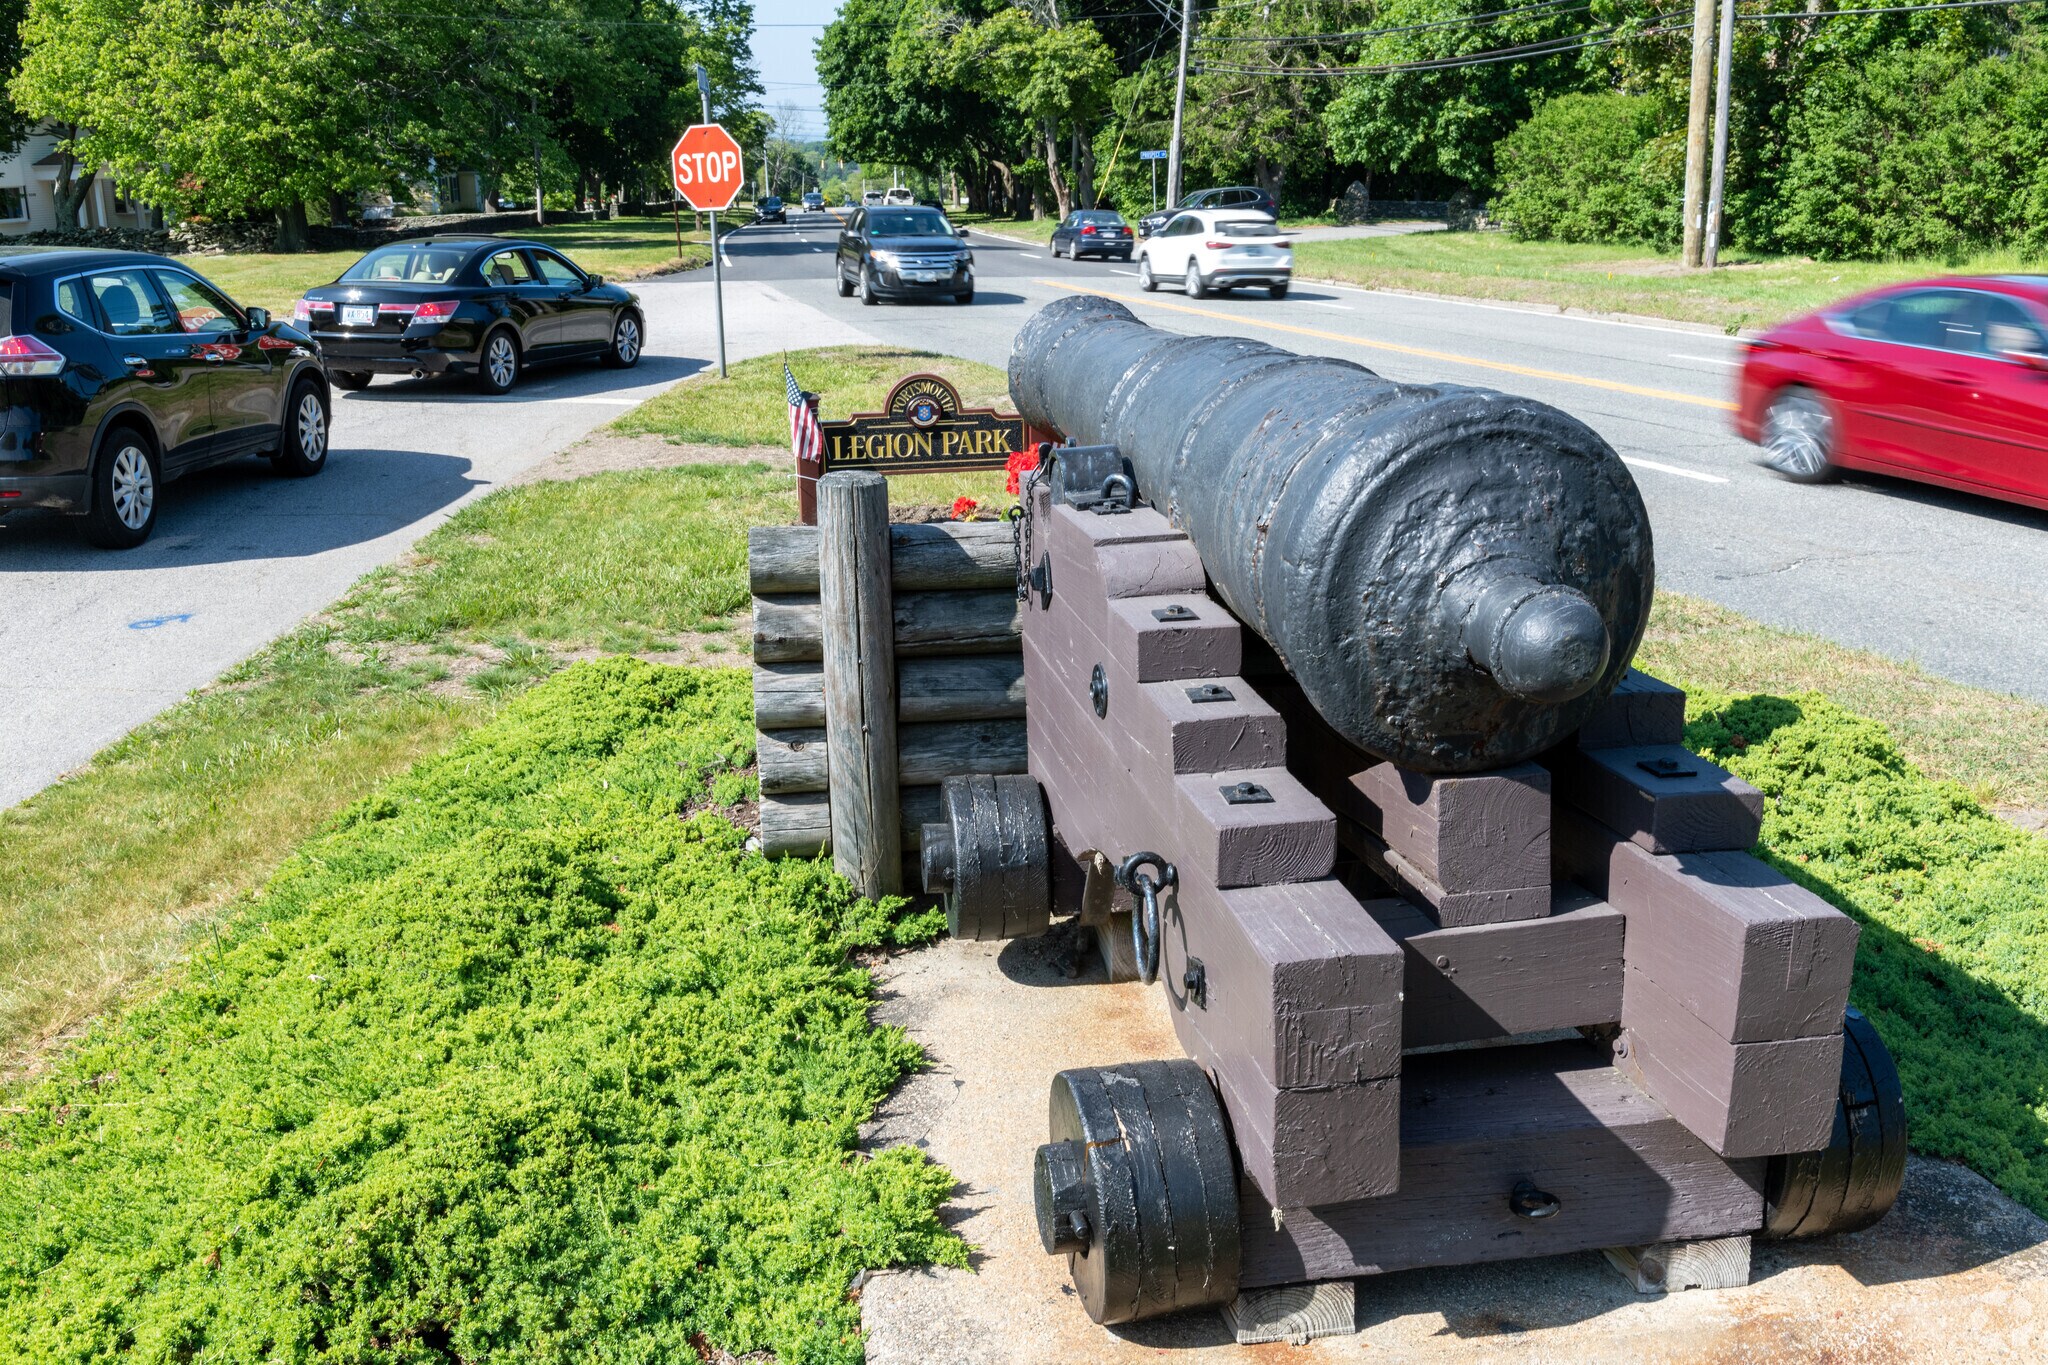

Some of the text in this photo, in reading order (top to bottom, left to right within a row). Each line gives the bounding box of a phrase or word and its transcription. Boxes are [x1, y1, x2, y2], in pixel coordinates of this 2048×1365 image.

[678, 151, 737, 185] STOP
[892, 381, 955, 413] PORTSMOUTH
[832, 428, 1013, 461] LEGION PARK
